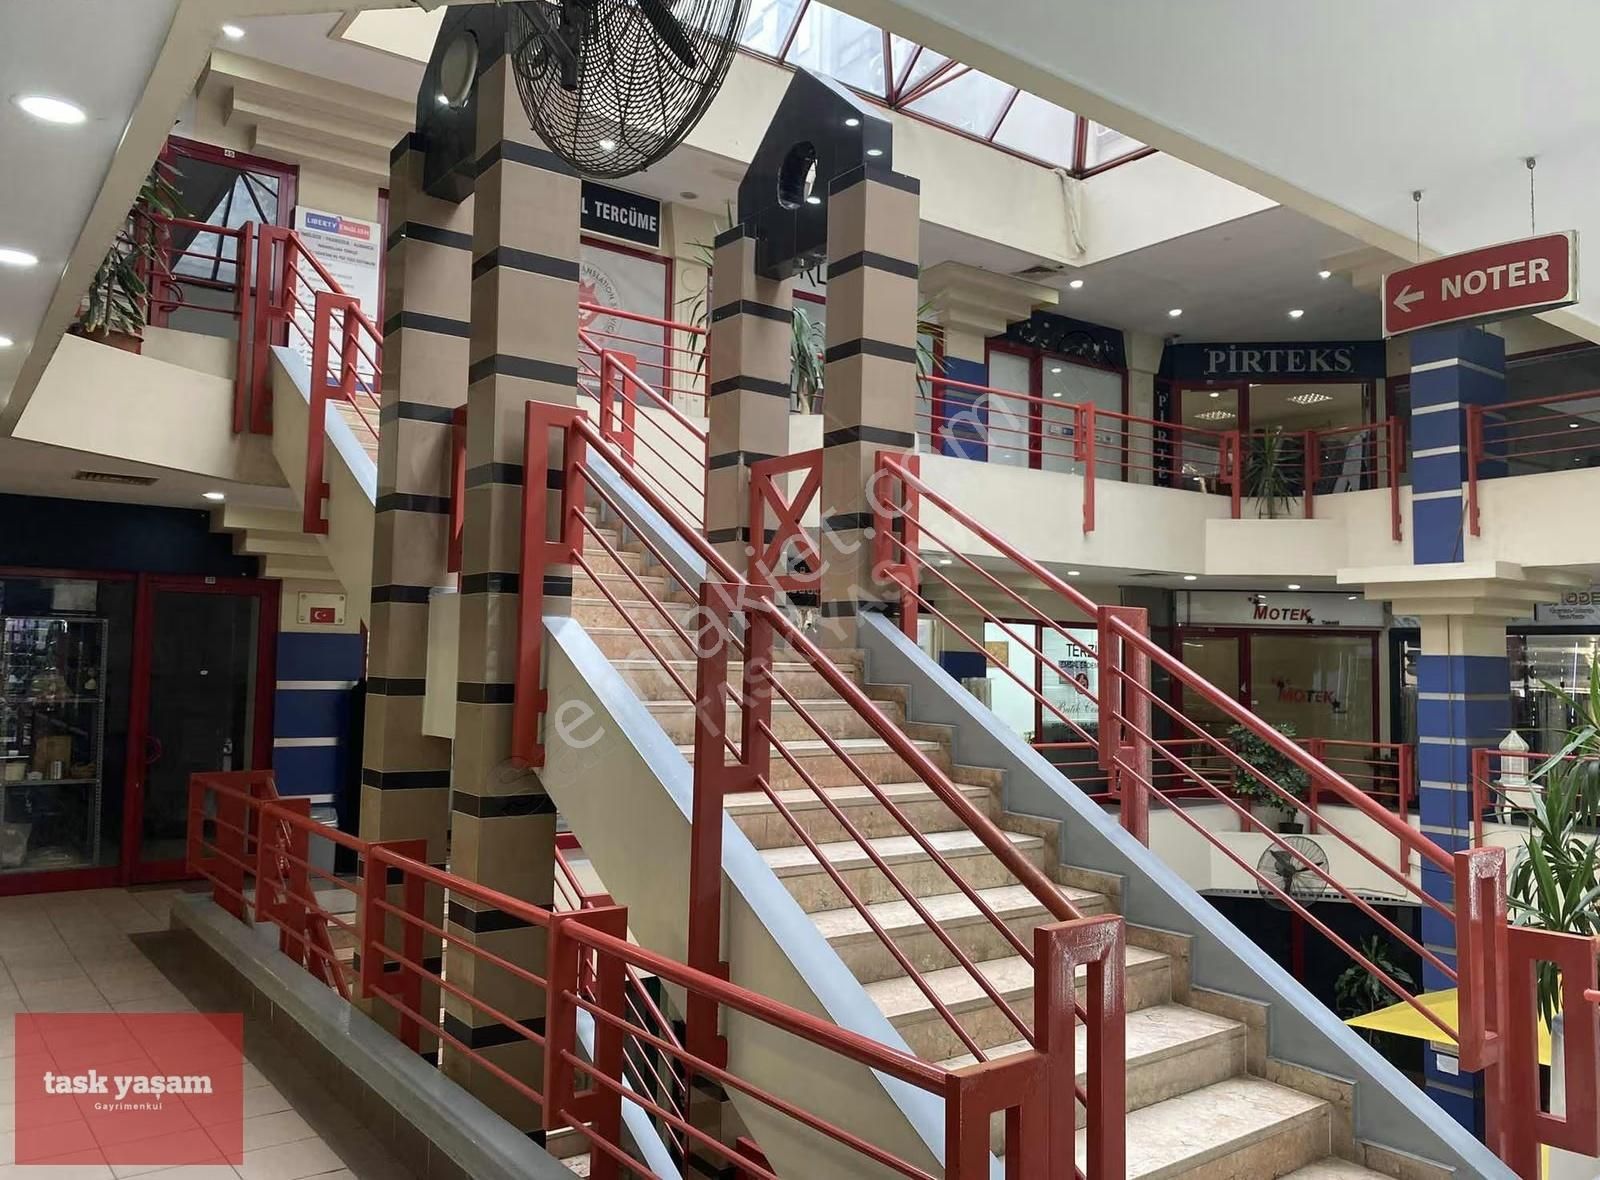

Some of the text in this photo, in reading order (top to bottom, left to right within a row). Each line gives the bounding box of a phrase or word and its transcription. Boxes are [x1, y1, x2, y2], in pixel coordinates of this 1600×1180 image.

[307, 217, 369, 236] LIBERTY ENGLISH
[594, 201, 657, 232] TERCÜME
[1441, 258, 1550, 301] NOTER
[1207, 345, 1353, 374] PİRTEKS
[1253, 606, 1311, 621] MOTEK
[1280, 689, 1335, 704] MOTEK
